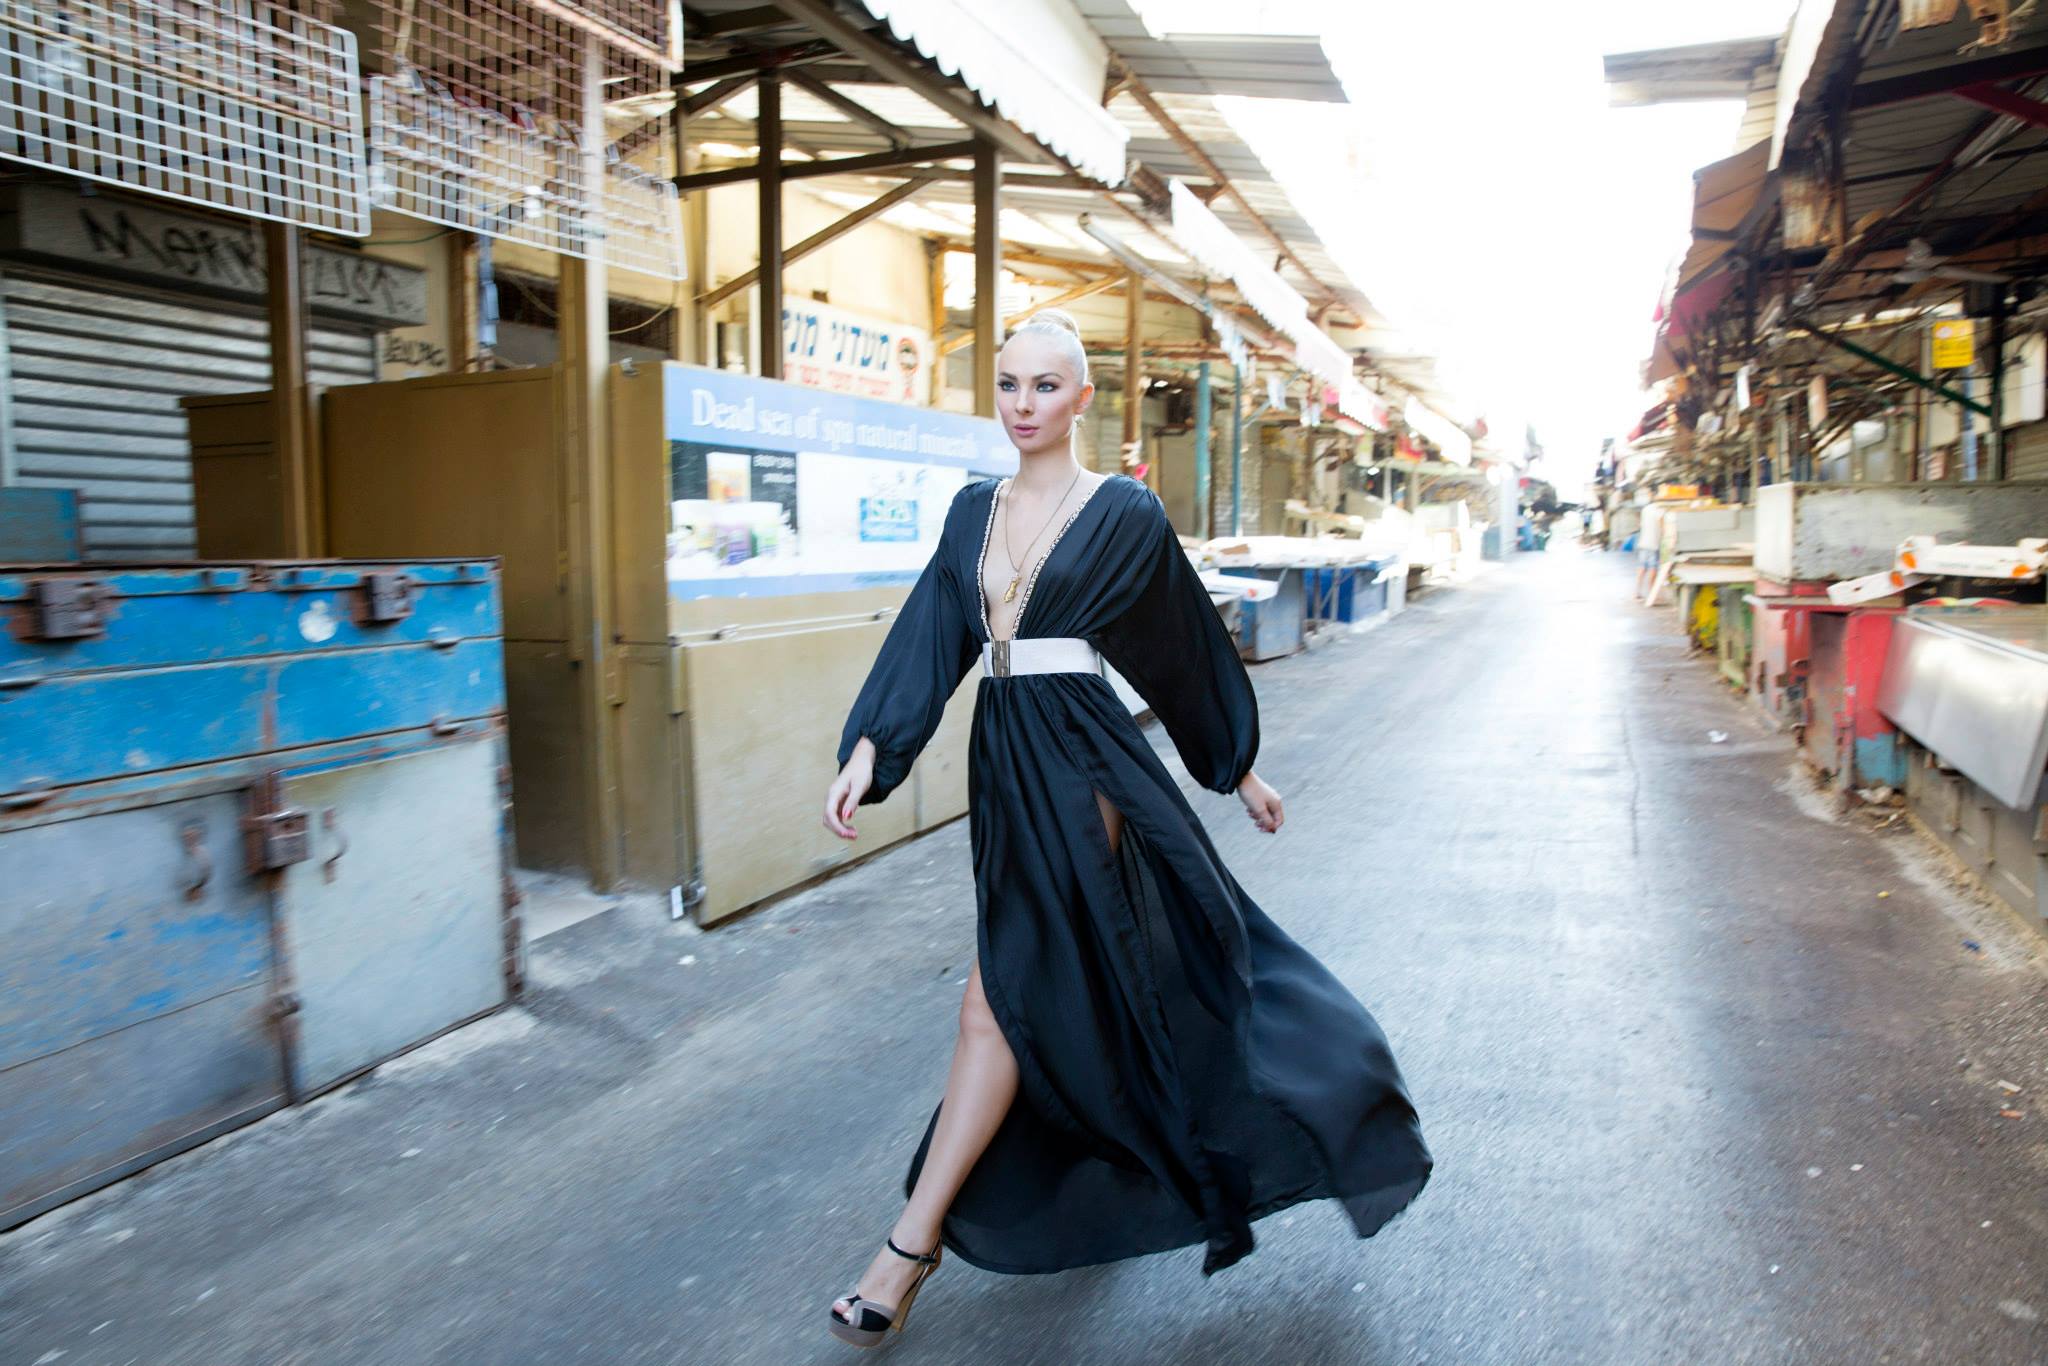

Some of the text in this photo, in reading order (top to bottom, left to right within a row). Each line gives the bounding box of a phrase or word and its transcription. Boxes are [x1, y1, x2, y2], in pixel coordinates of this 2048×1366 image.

[692, 388, 756, 433] Dead
[758, 407, 793, 438] sea
[794, 407, 820, 439] of
[821, 419, 855, 452] spa
[856, 423, 918, 452] natural
